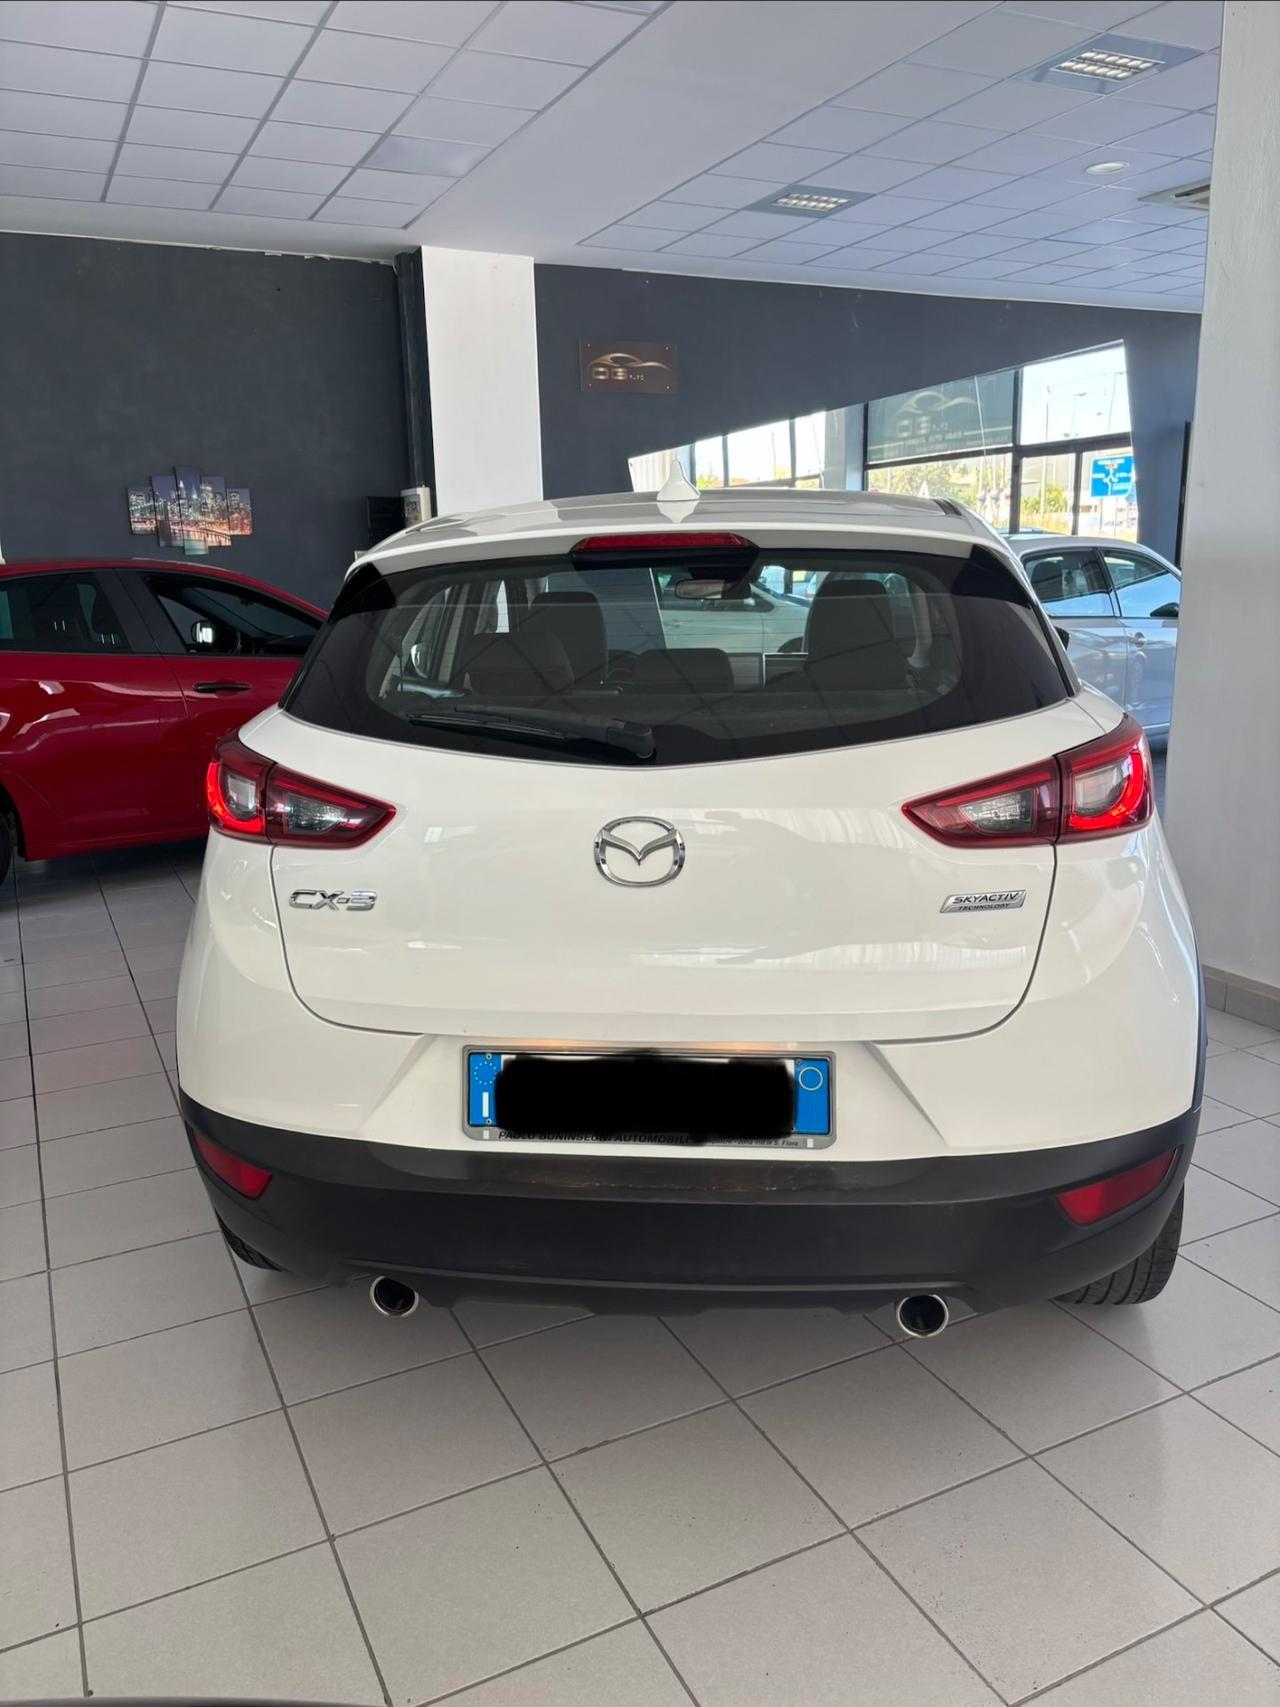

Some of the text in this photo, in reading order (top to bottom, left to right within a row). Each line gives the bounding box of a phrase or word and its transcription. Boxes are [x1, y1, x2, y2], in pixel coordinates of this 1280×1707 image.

[289, 889, 377, 911] CX-3
[952, 892, 1019, 904] SKYACTIV
[958, 903, 1010, 911] TECHNOLOGY
